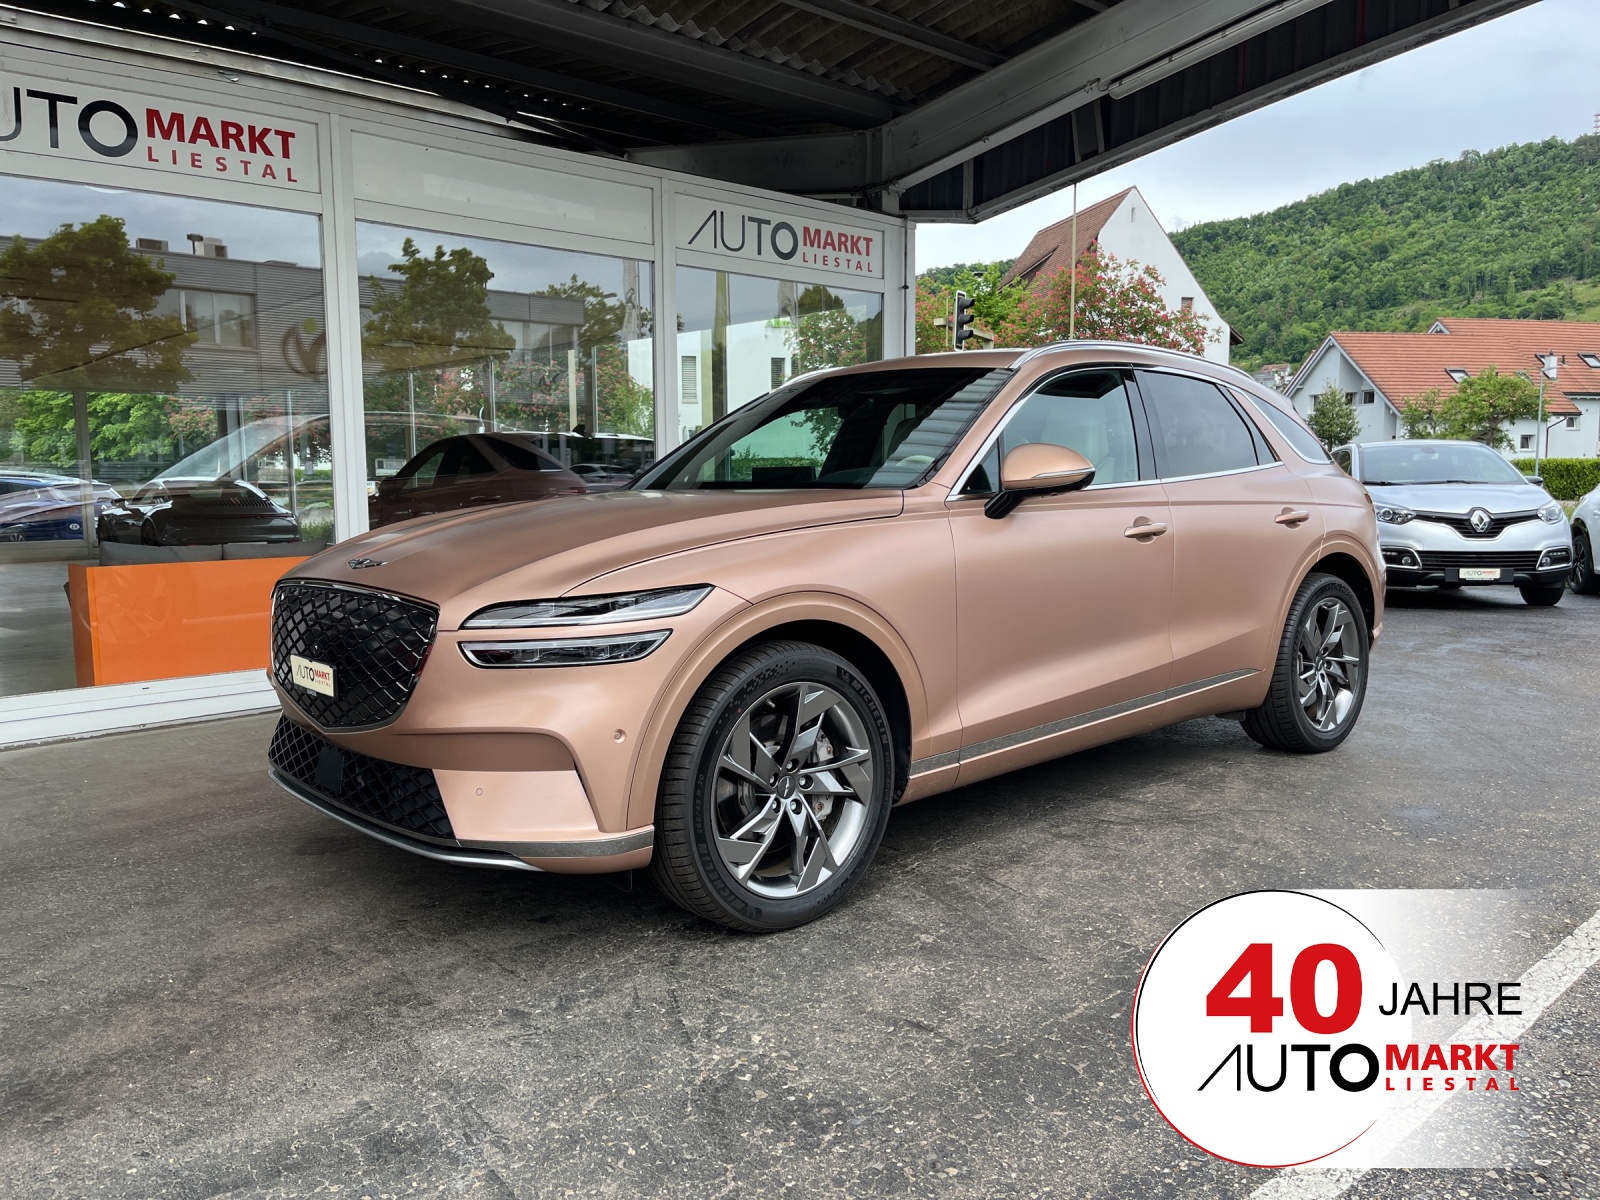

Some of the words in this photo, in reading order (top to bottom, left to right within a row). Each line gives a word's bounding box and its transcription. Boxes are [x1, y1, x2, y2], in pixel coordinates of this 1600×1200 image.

[145, 108, 296, 159] MARKT
[147, 146, 298, 183] LIESTAL
[687, 209, 799, 261] AUTO
[802, 226, 873, 257] MARKT
[802, 252, 873, 273] LIESTAL
[297, 665, 314, 681] AUTO
[314, 669, 330, 681] MARKT
[851, 679, 889, 744] MICHELIN
